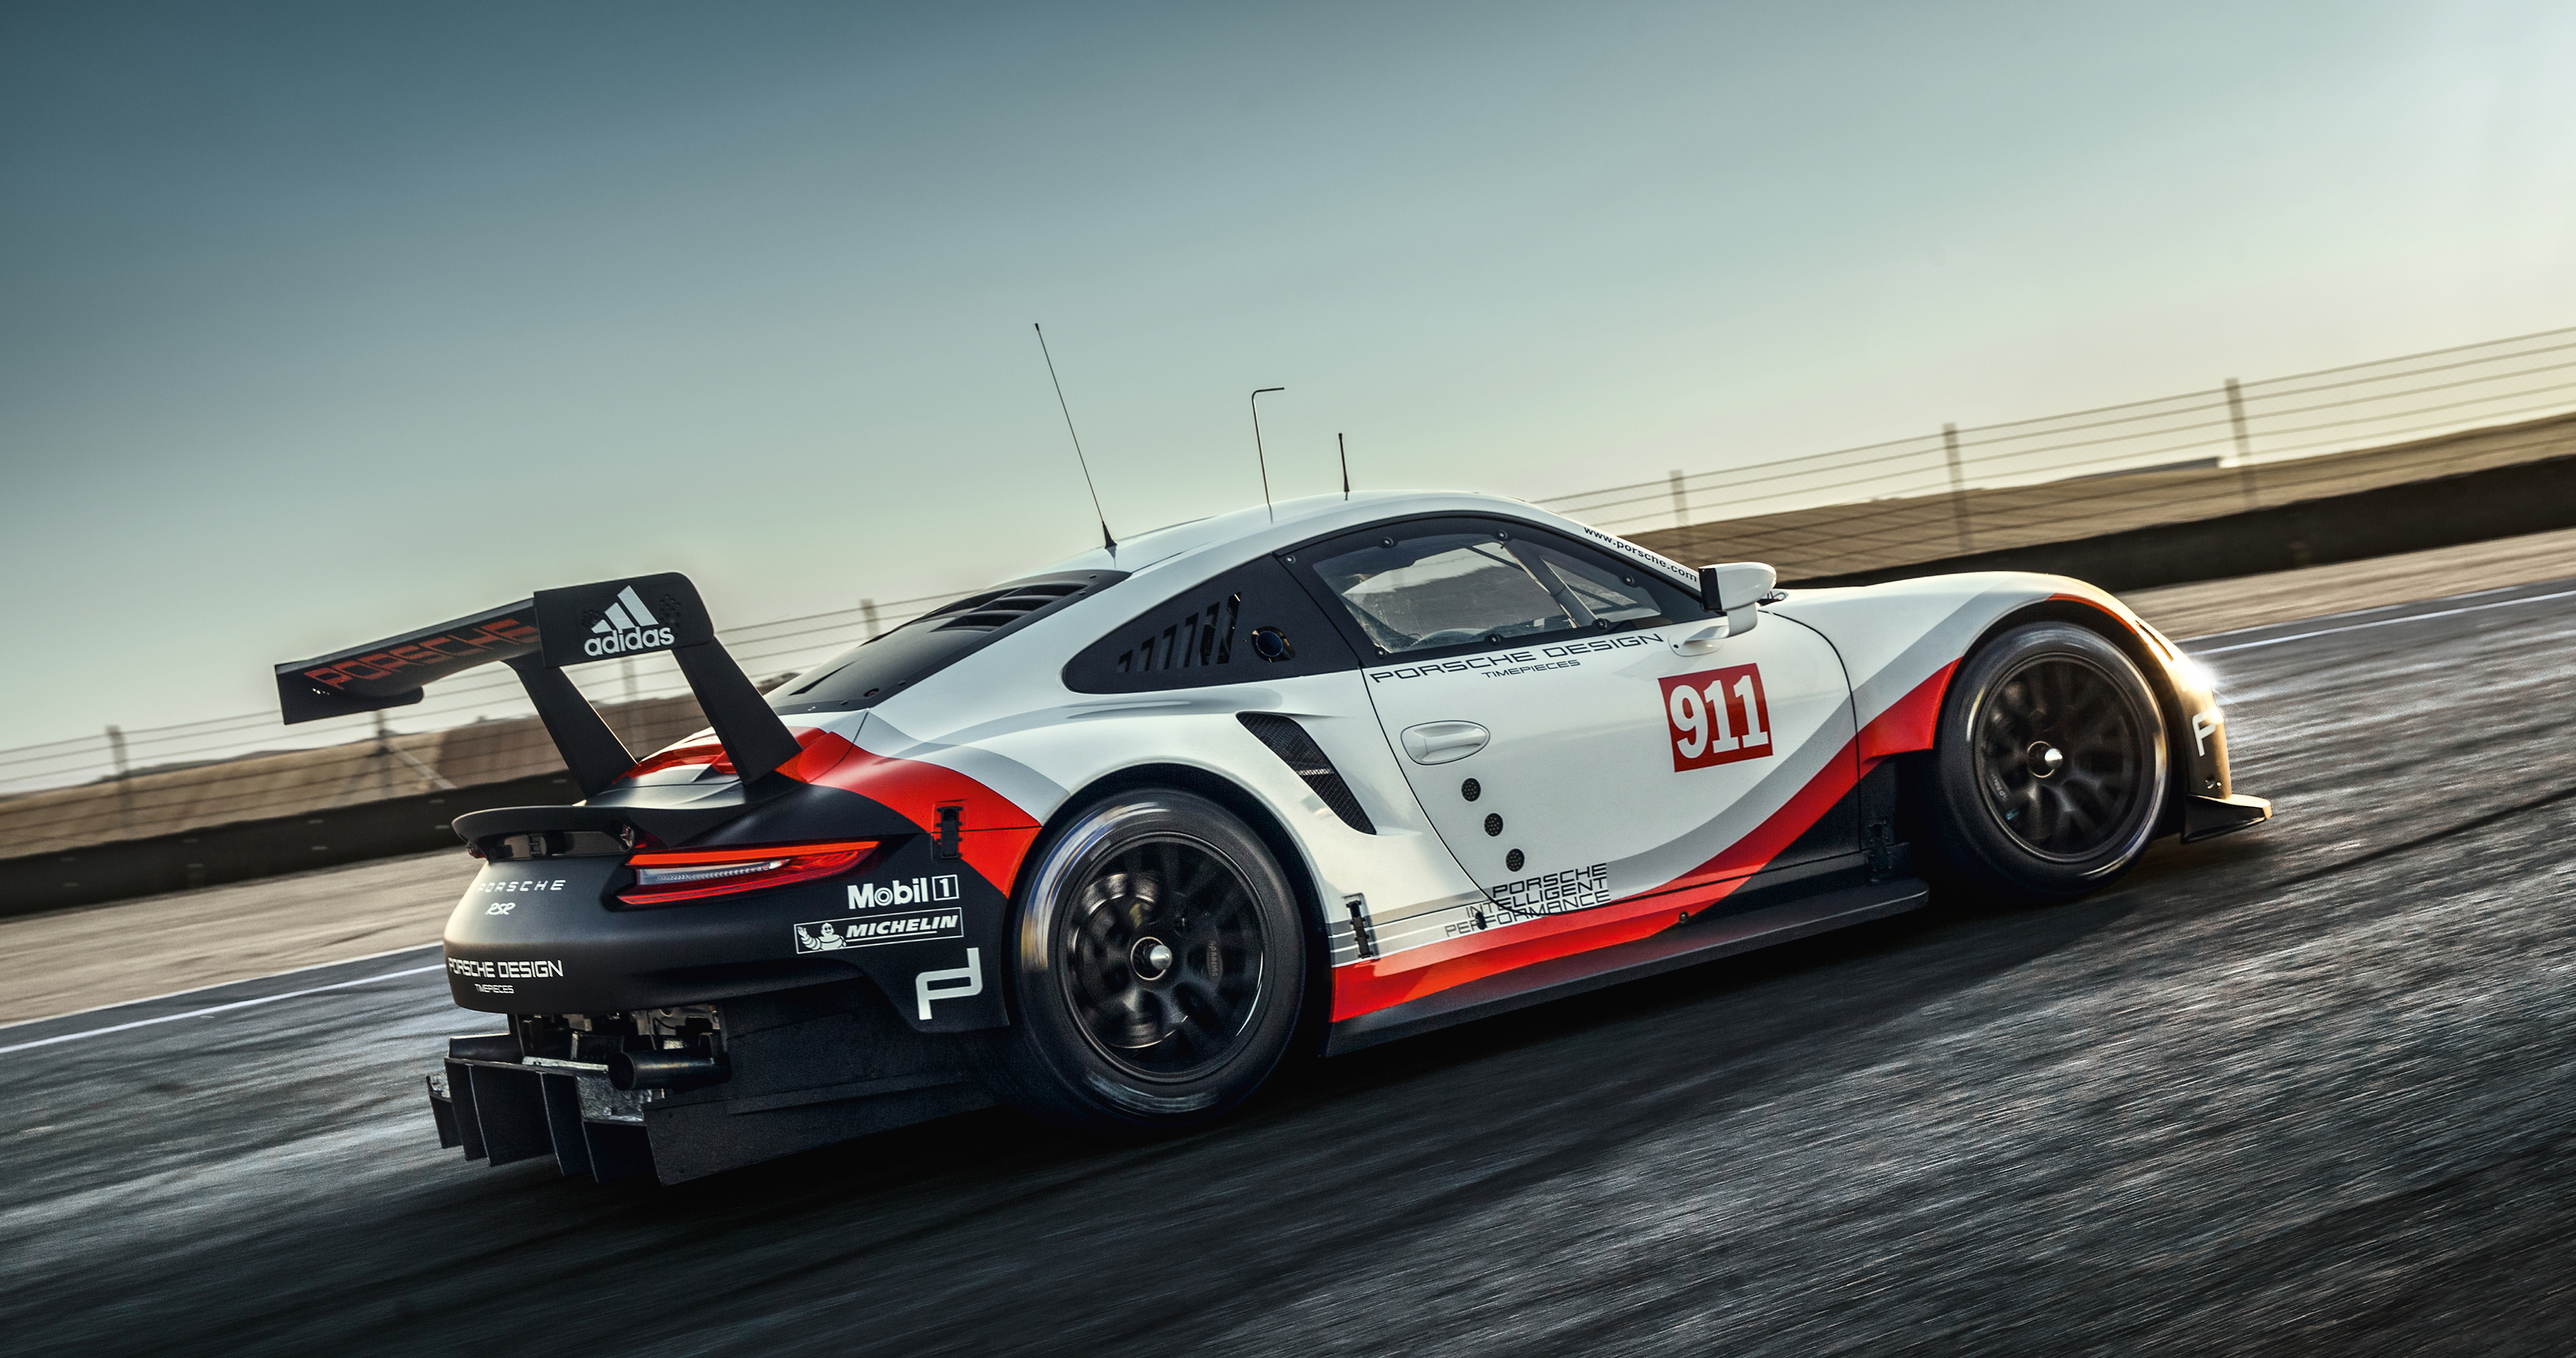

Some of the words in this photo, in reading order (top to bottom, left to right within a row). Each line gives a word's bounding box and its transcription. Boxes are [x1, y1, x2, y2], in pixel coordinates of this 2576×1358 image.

[1584, 526, 1697, 582] www.porsche.com
[304, 618, 539, 689] PORSCHE
[584, 626, 675, 656] adidas
[1369, 650, 1537, 683] PORSCHE
[1543, 633, 1664, 659] DESIGN
[1481, 659, 1580, 679] TIMEPIECES
[1668, 675, 1769, 759] 911
[477, 880, 566, 893] PORSCHE
[847, 877, 929, 909] Mobil
[1493, 863, 1607, 898] PORSCHE
[485, 903, 516, 915] RSR
[1444, 889, 1611, 938] PERFORMANCE
[1466, 876, 1607, 919] INTELLIGENT
[846, 915, 958, 938] MICHELIN
[448, 957, 496, 978] PORSCHE
[497, 960, 564, 978] DESIGN
